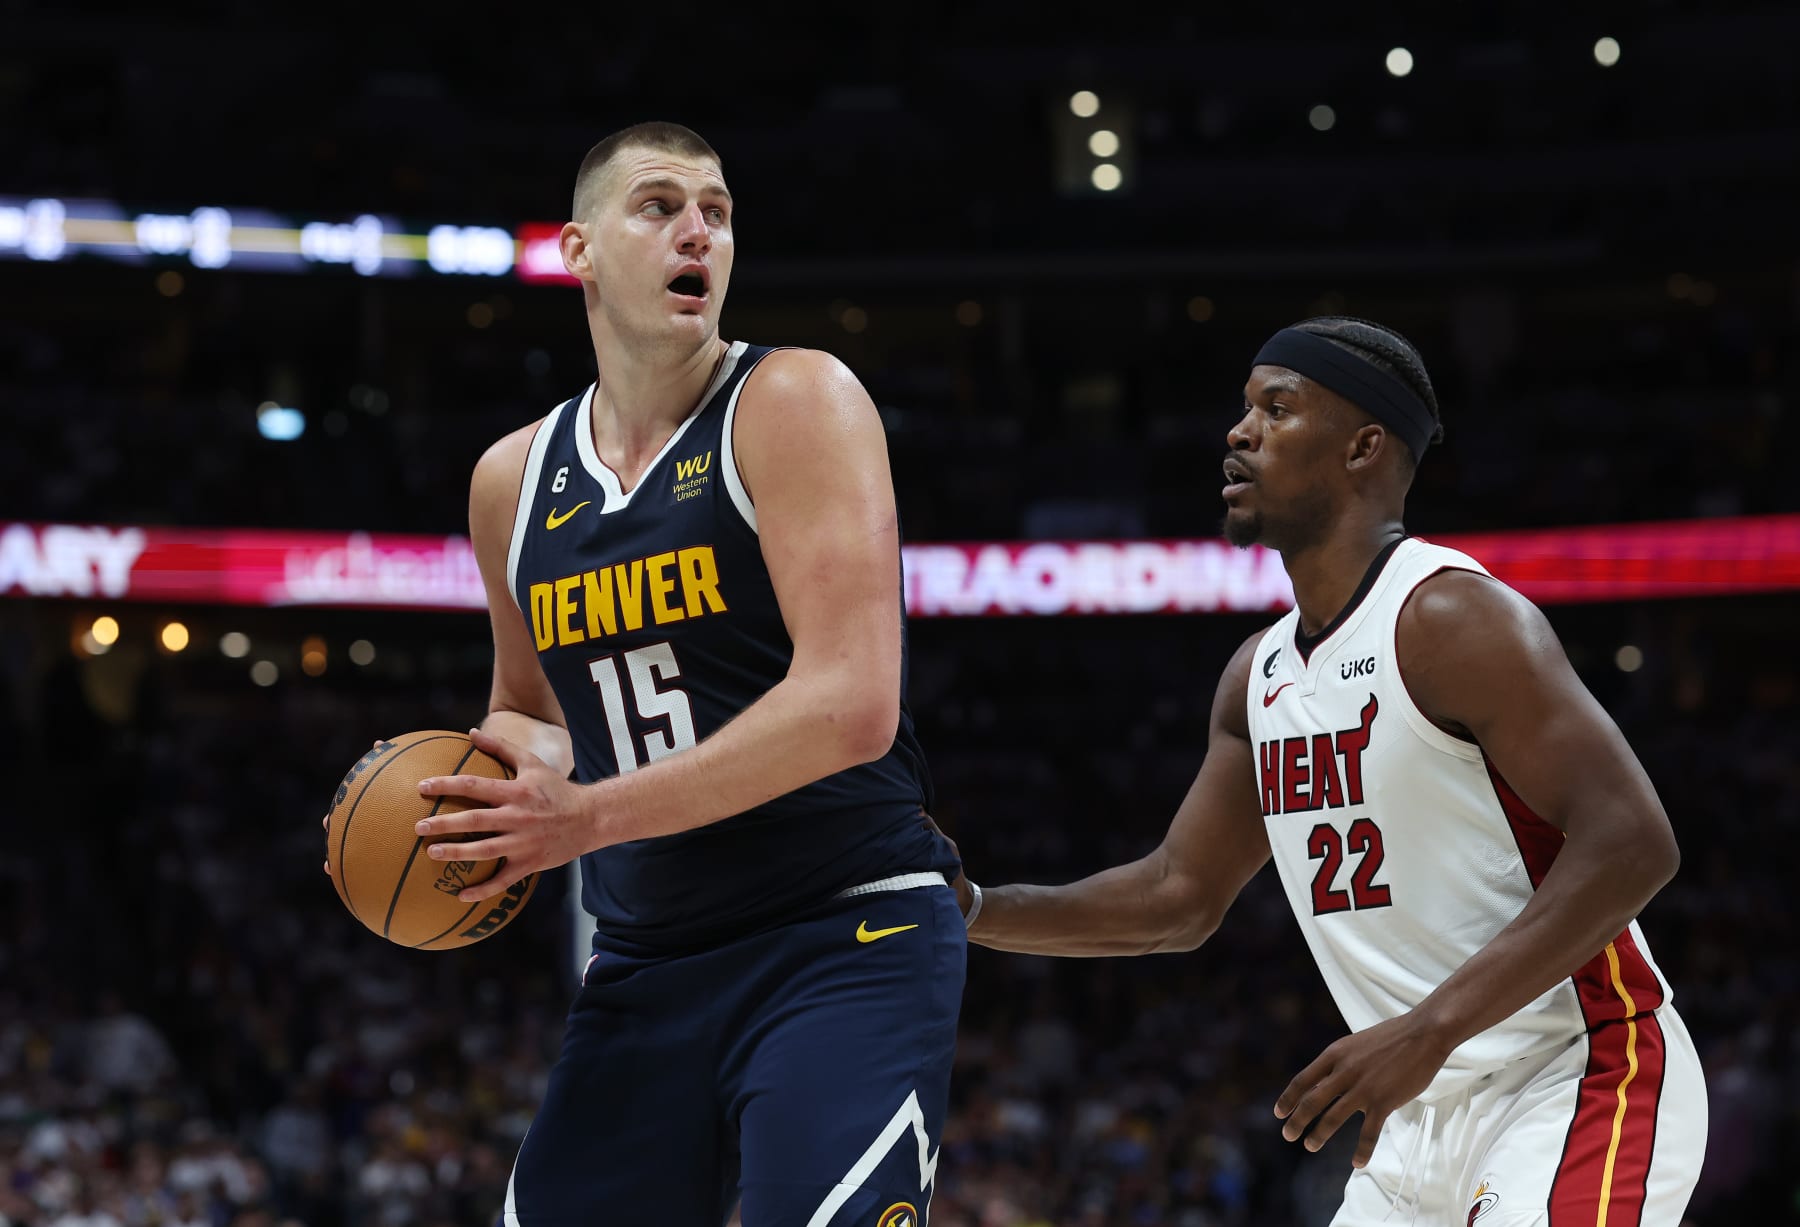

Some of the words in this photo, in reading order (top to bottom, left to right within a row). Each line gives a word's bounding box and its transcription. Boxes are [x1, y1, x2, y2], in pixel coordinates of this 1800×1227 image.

[551, 466, 569, 493] 6
[673, 476, 708, 494] Western
[676, 450, 712, 481] WU
[677, 488, 702, 502] Union
[529, 544, 728, 652] DENVER
[587, 640, 698, 776] 15
[1260, 692, 1378, 816] HEAT
[1307, 818, 1393, 916] 22
